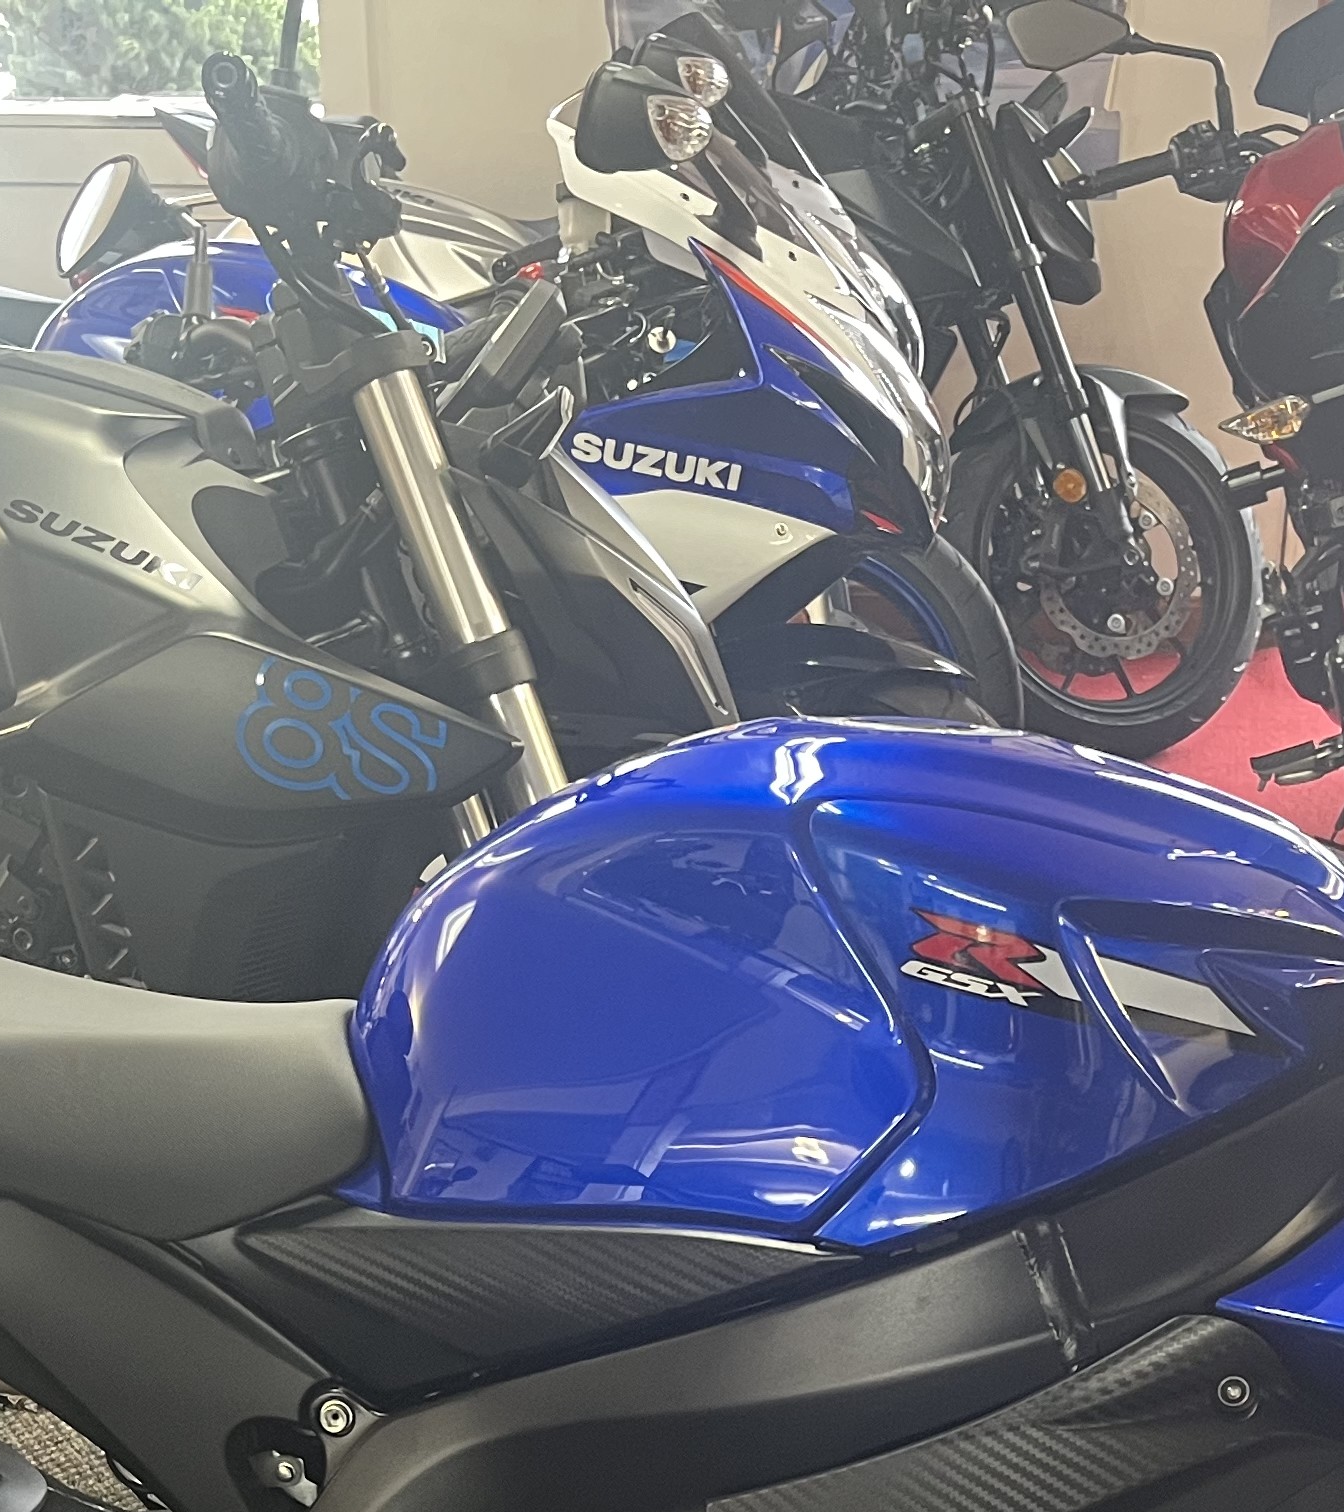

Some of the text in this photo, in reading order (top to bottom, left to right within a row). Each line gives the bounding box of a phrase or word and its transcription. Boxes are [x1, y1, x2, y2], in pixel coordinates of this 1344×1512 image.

[570, 432, 742, 491] SUZUKI
[3, 499, 204, 590] SUZUKI
[900, 960, 1045, 1007] GSX
